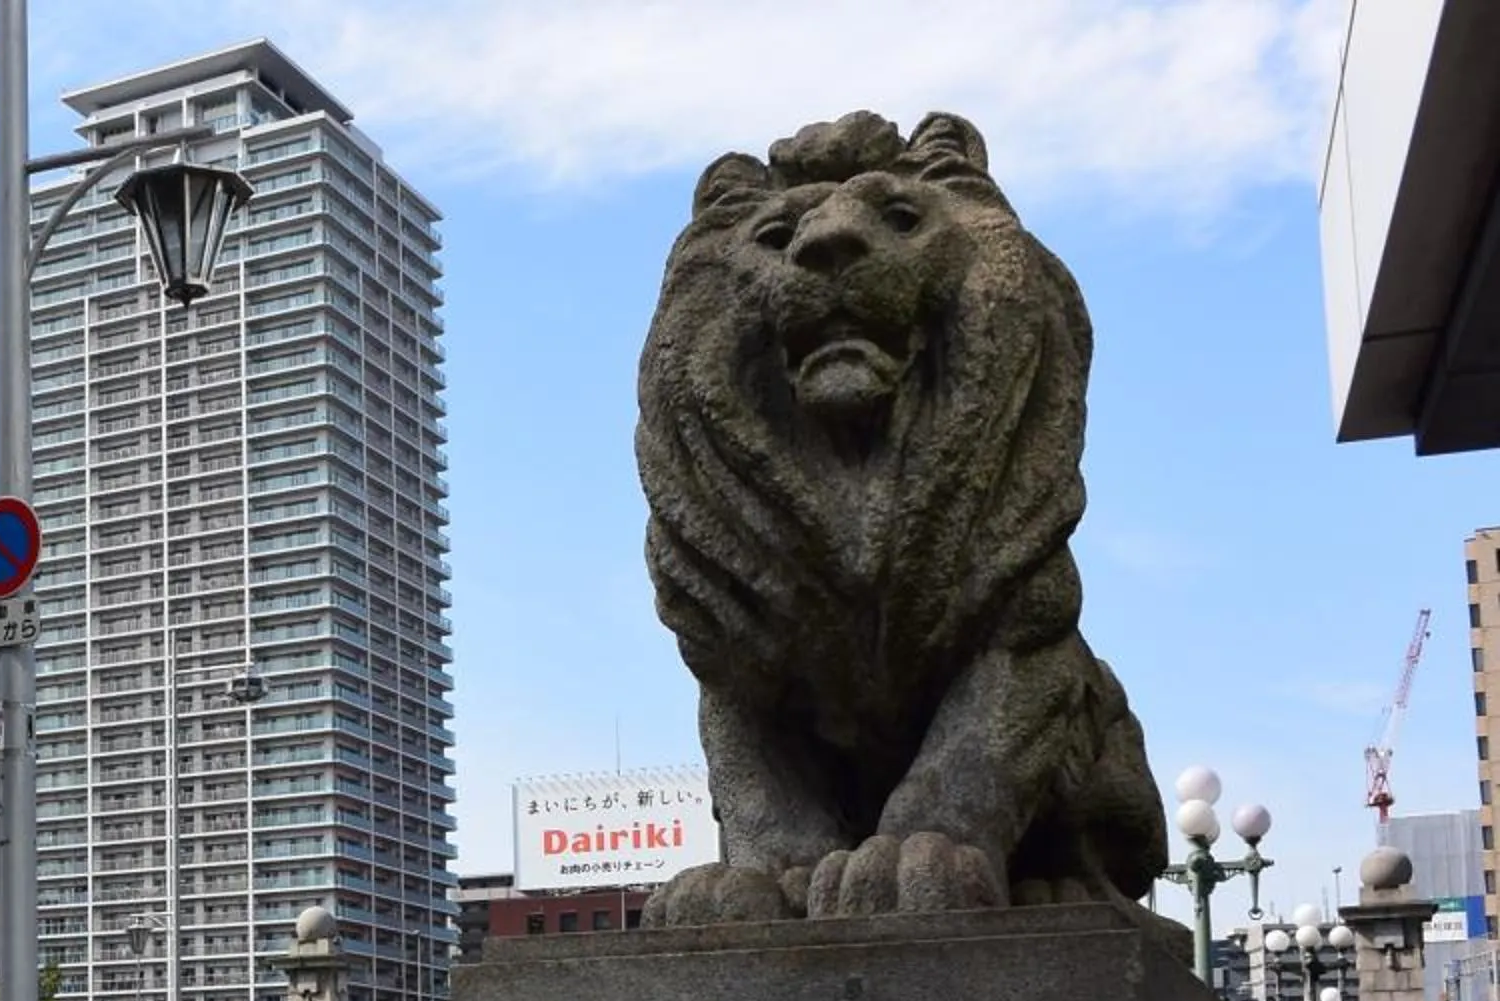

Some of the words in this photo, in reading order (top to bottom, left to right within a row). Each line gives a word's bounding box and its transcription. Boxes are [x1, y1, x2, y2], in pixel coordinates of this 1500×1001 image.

[527, 789, 704, 815] まいにちが、新しい。
[542, 819, 684, 855] Dairiki
